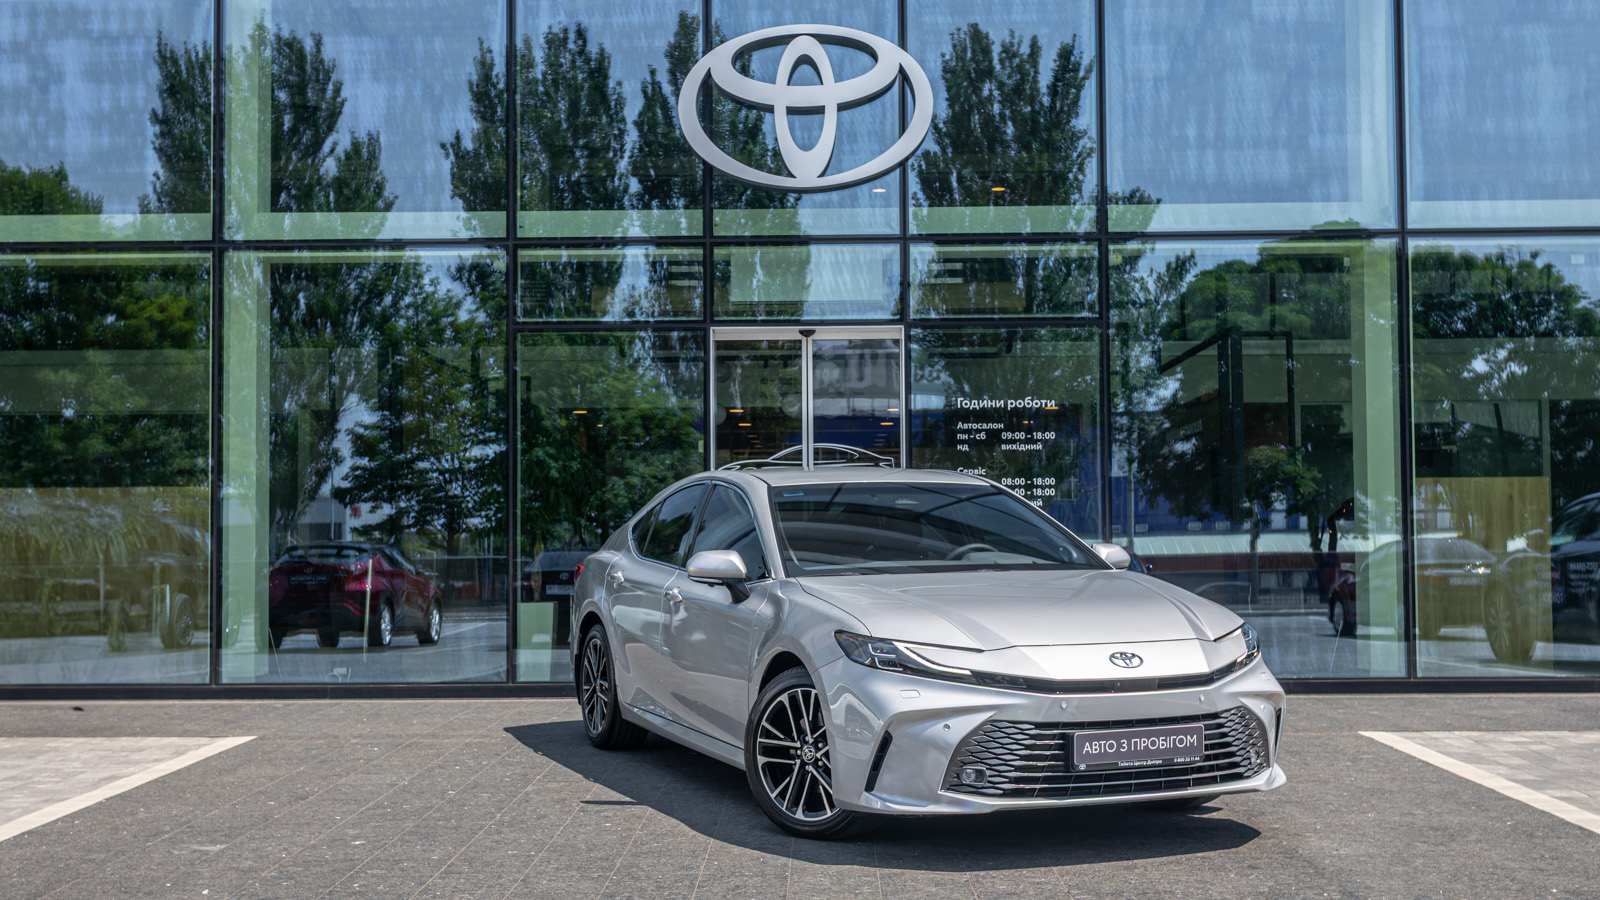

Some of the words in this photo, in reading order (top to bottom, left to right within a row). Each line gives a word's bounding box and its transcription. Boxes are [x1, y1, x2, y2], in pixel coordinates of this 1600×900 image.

[957, 397, 1004, 410] Години
[1007, 396, 1055, 410] роботи
[957, 422, 1004, 430] Автосалон
[976, 432, 986, 440] сб
[1001, 431, 1025, 440] 09:00
[1033, 431, 1056, 440] 18:00
[957, 444, 969, 452] нд
[1001, 442, 1043, 452] вихідний
[1001, 477, 1025, 486] 08:00
[1033, 477, 1056, 486] 18:00
[1033, 487, 1056, 496] 18:00
[1083, 740, 1117, 754] АВТО
[1131, 734, 1197, 751] ПРОБІГОМ
